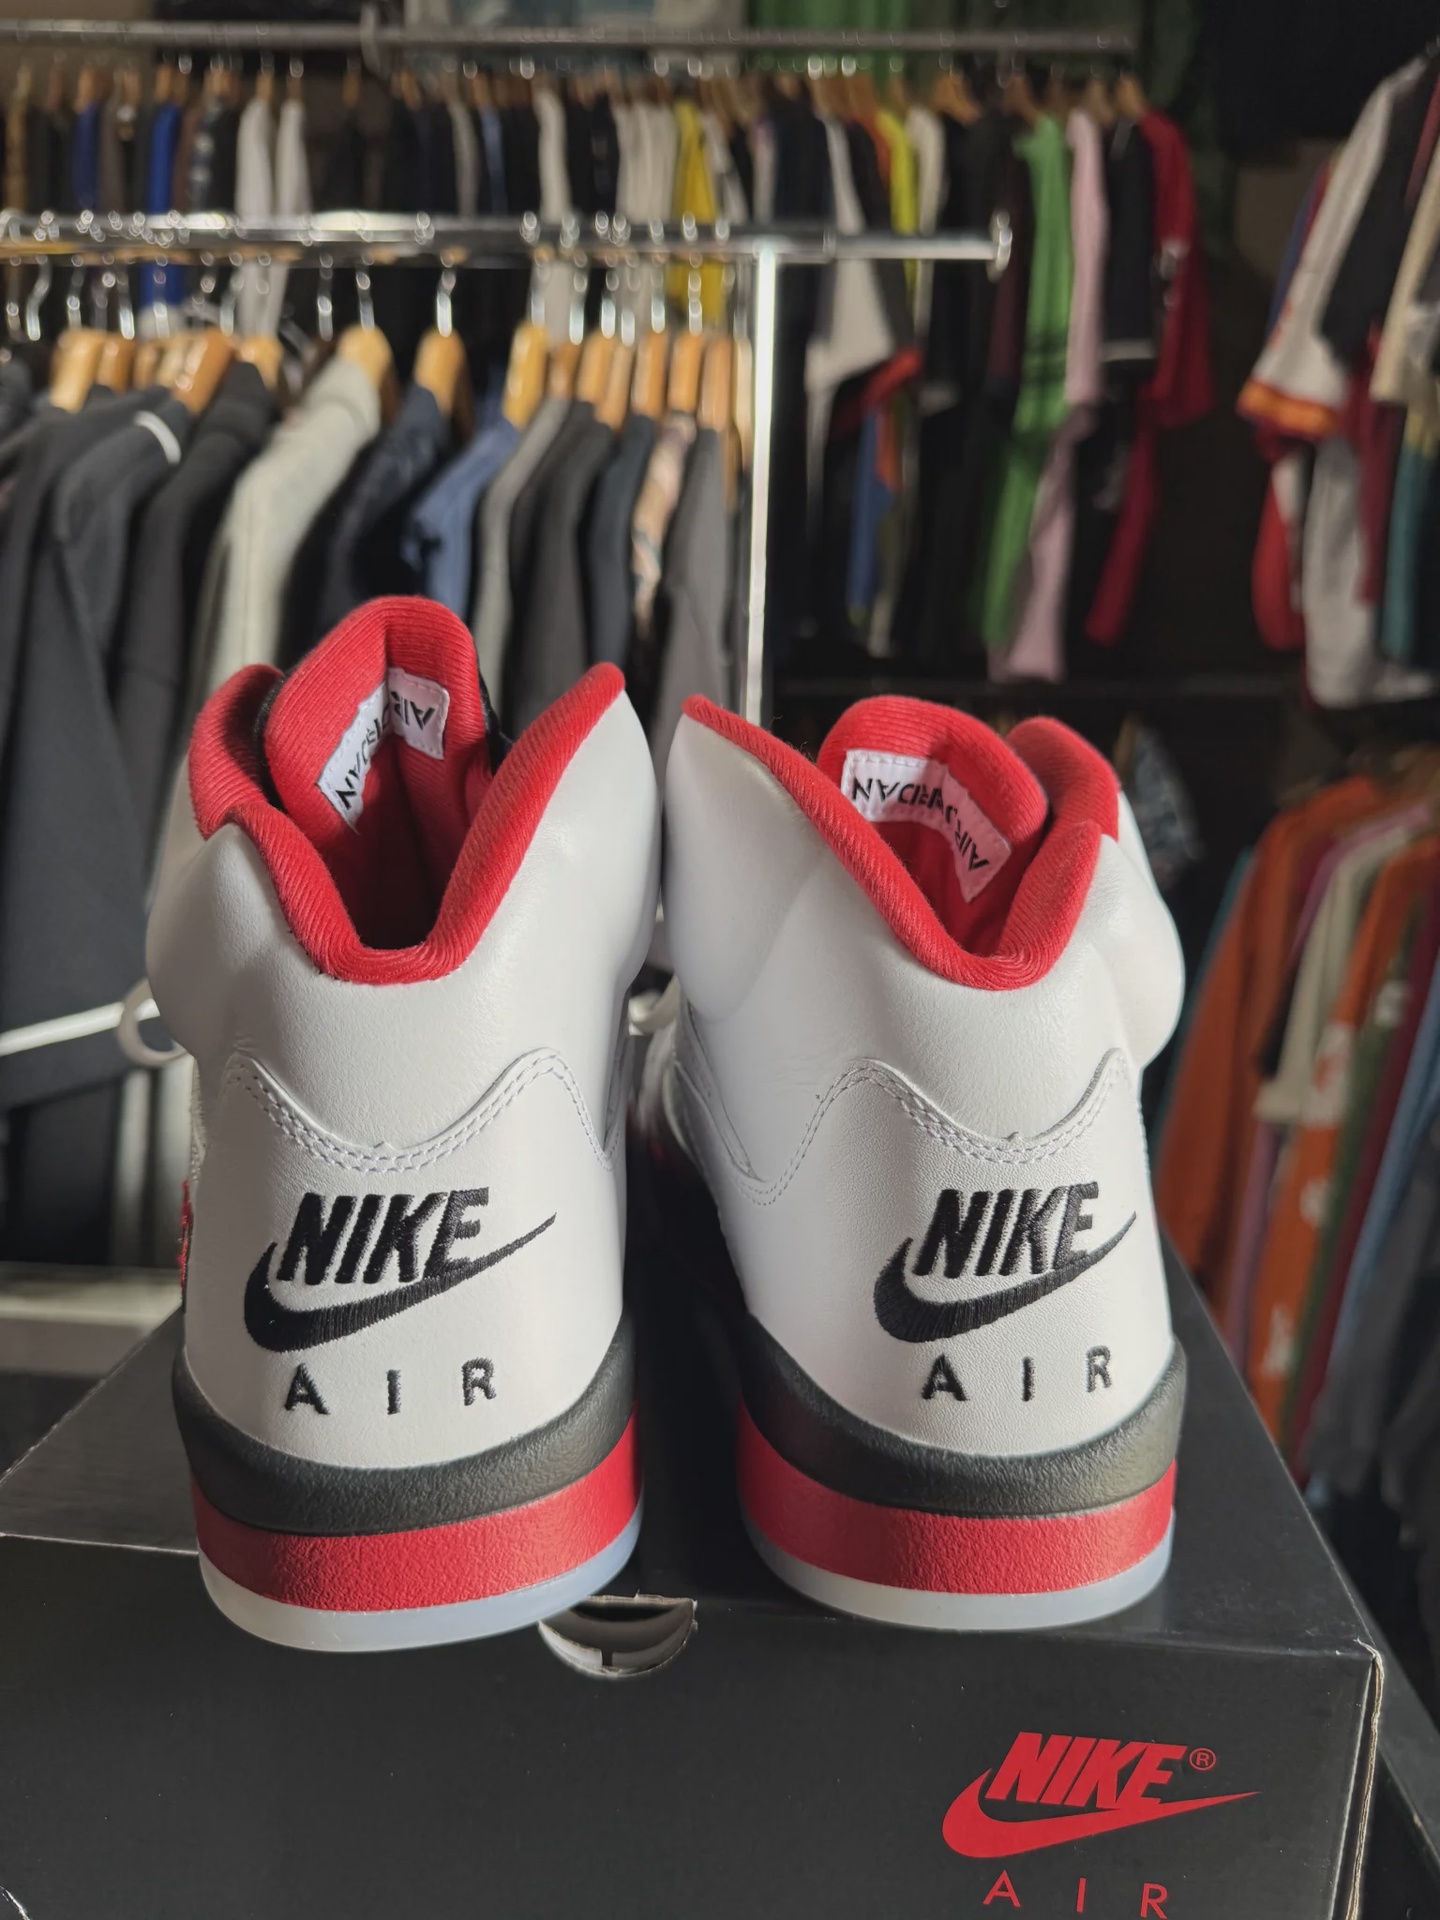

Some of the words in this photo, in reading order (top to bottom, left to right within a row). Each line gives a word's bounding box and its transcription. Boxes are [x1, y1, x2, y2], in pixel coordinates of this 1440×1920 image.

[335, 704, 390, 810] RDAN
[954, 819, 990, 872] AIR
[277, 1187, 489, 1285] NIKE
[912, 1181, 1099, 1279] NIKE
[285, 1357, 496, 1415] AIR
[921, 1345, 1112, 1402] AIR
[982, 1869, 1168, 1919] AIR
